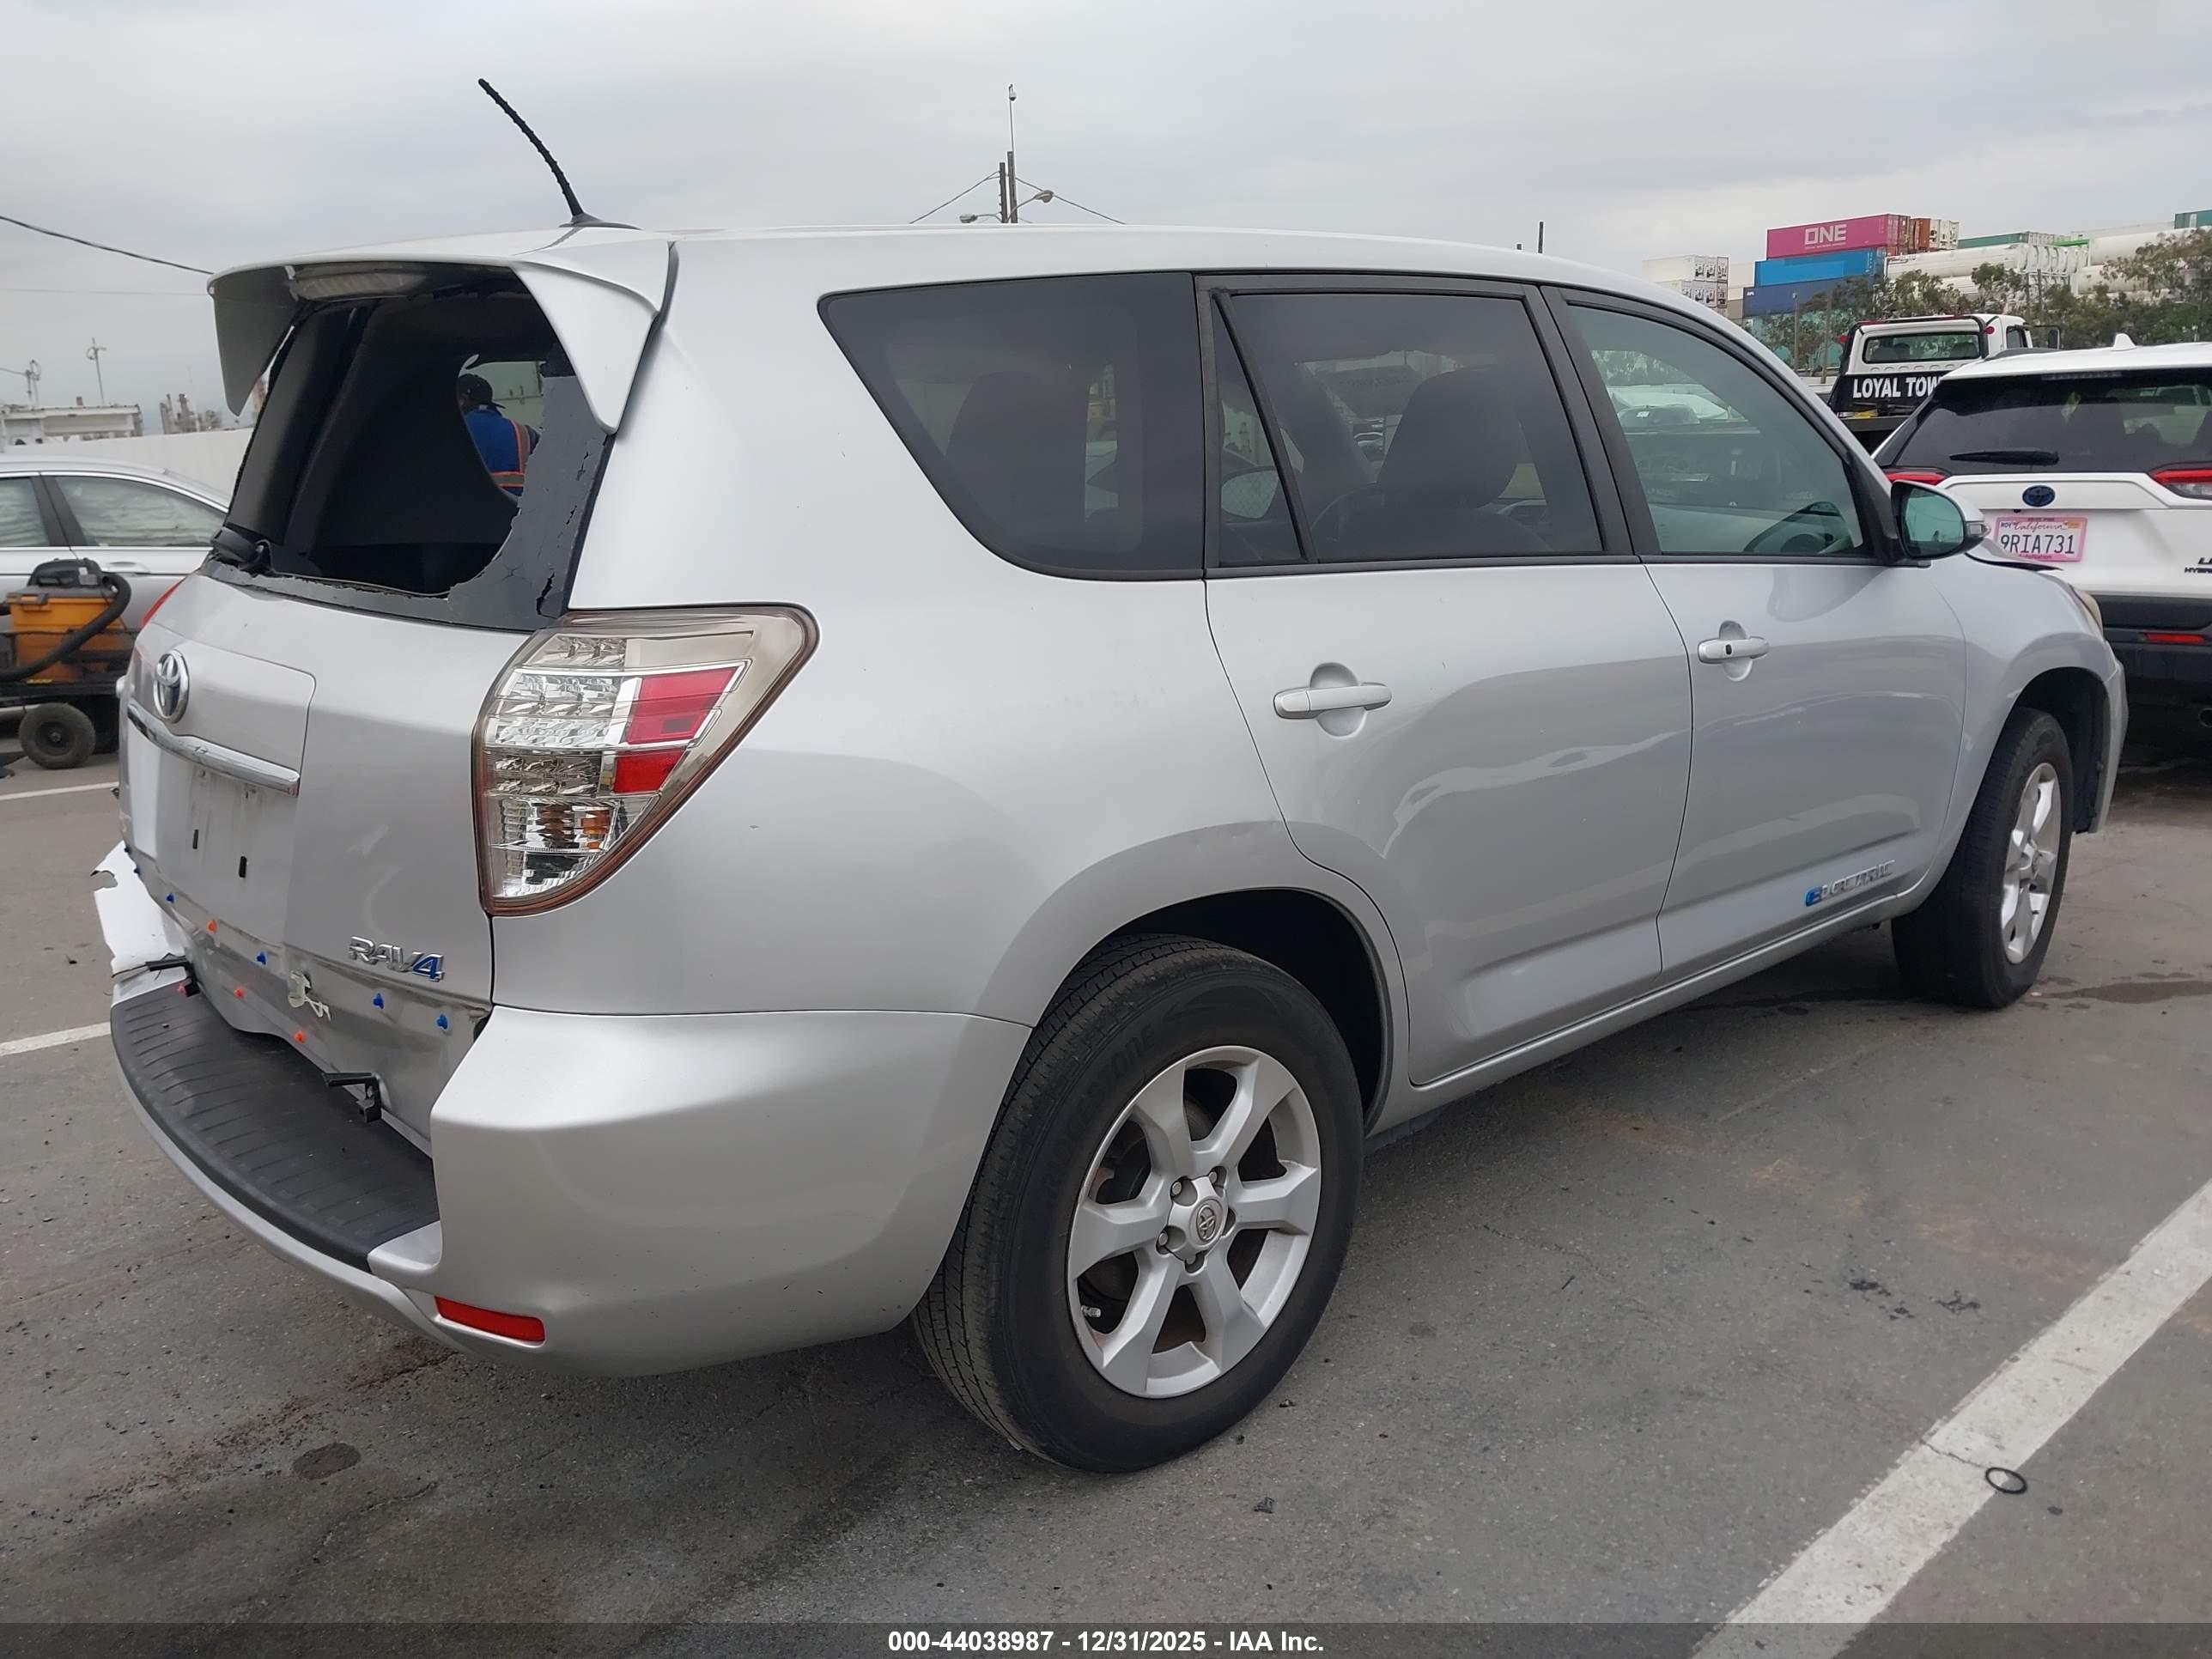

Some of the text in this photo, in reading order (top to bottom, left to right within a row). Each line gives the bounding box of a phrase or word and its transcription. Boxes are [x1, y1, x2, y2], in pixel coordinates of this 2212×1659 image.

[1805, 223, 1847, 245] ONE
[1853, 378, 1901, 398] LOYAL
[2000, 534, 2075, 555] 9RIA731
[349, 935, 445, 982] RAV4
